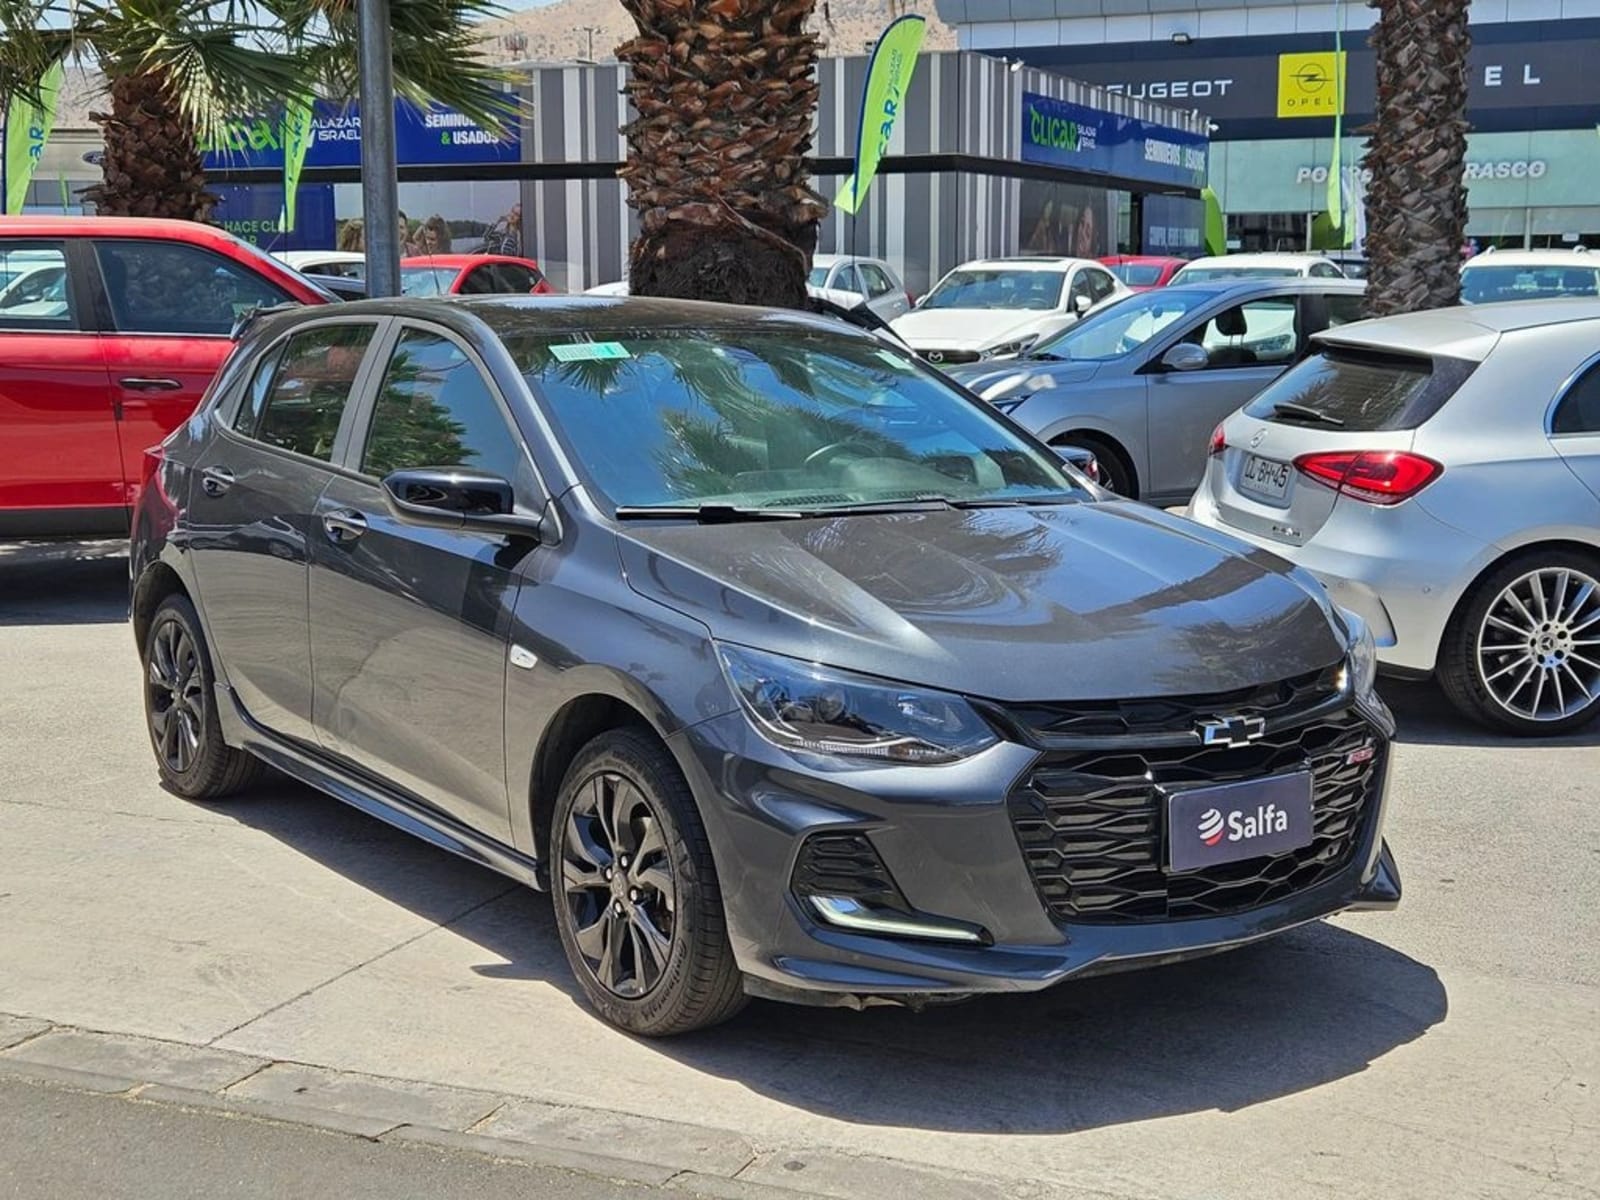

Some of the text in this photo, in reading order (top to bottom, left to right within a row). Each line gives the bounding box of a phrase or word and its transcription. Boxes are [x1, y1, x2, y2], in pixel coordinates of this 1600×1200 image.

[1106, 79, 1233, 100] EUGEOT
[1287, 97, 1335, 107] OPEL
[310, 117, 361, 129] ALAZAR
[318, 129, 361, 141] ISRAEL
[441, 130, 499, 145] & USADOS
[224, 221, 279, 233] HACE CL
[1228, 803, 1288, 842] Salfa
